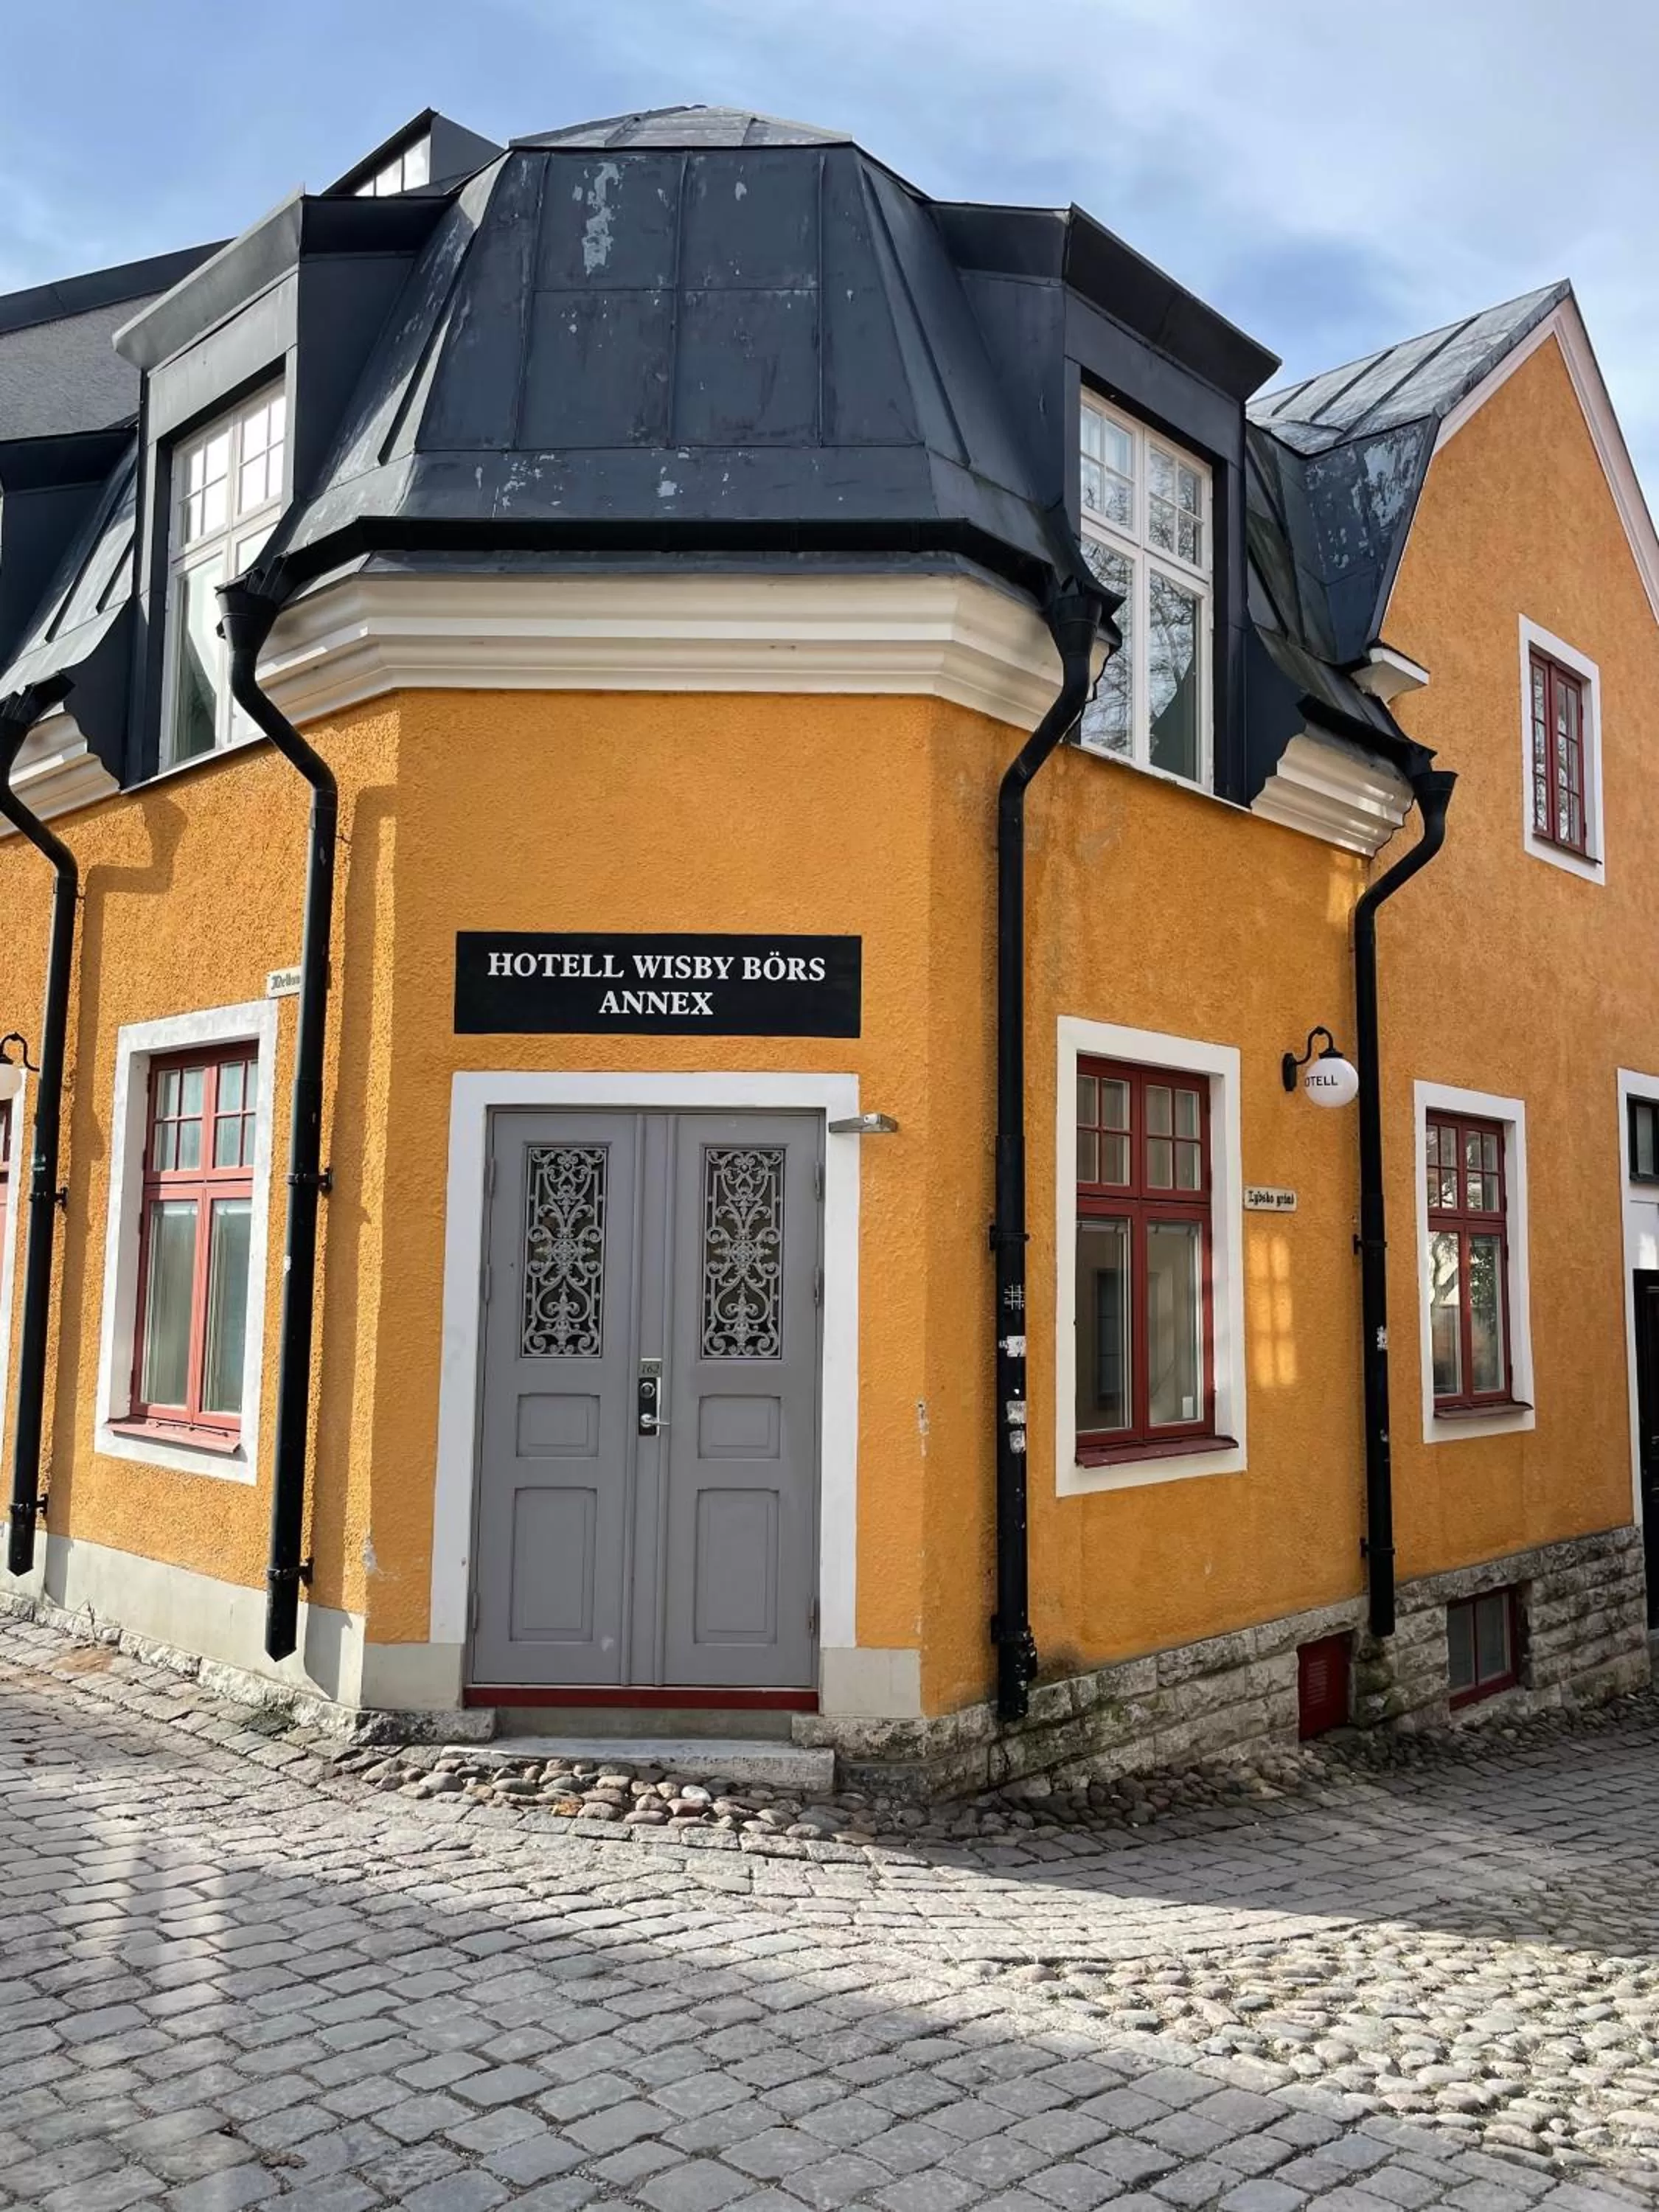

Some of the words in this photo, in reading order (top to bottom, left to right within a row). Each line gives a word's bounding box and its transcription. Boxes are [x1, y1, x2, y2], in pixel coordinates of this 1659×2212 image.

[487, 951, 625, 978] HOTELL
[633, 955, 735, 980] WISBY
[742, 951, 827, 981] BÖRS
[599, 990, 714, 1016] ANNEX
[1304, 1074, 1338, 1087] OTELL
